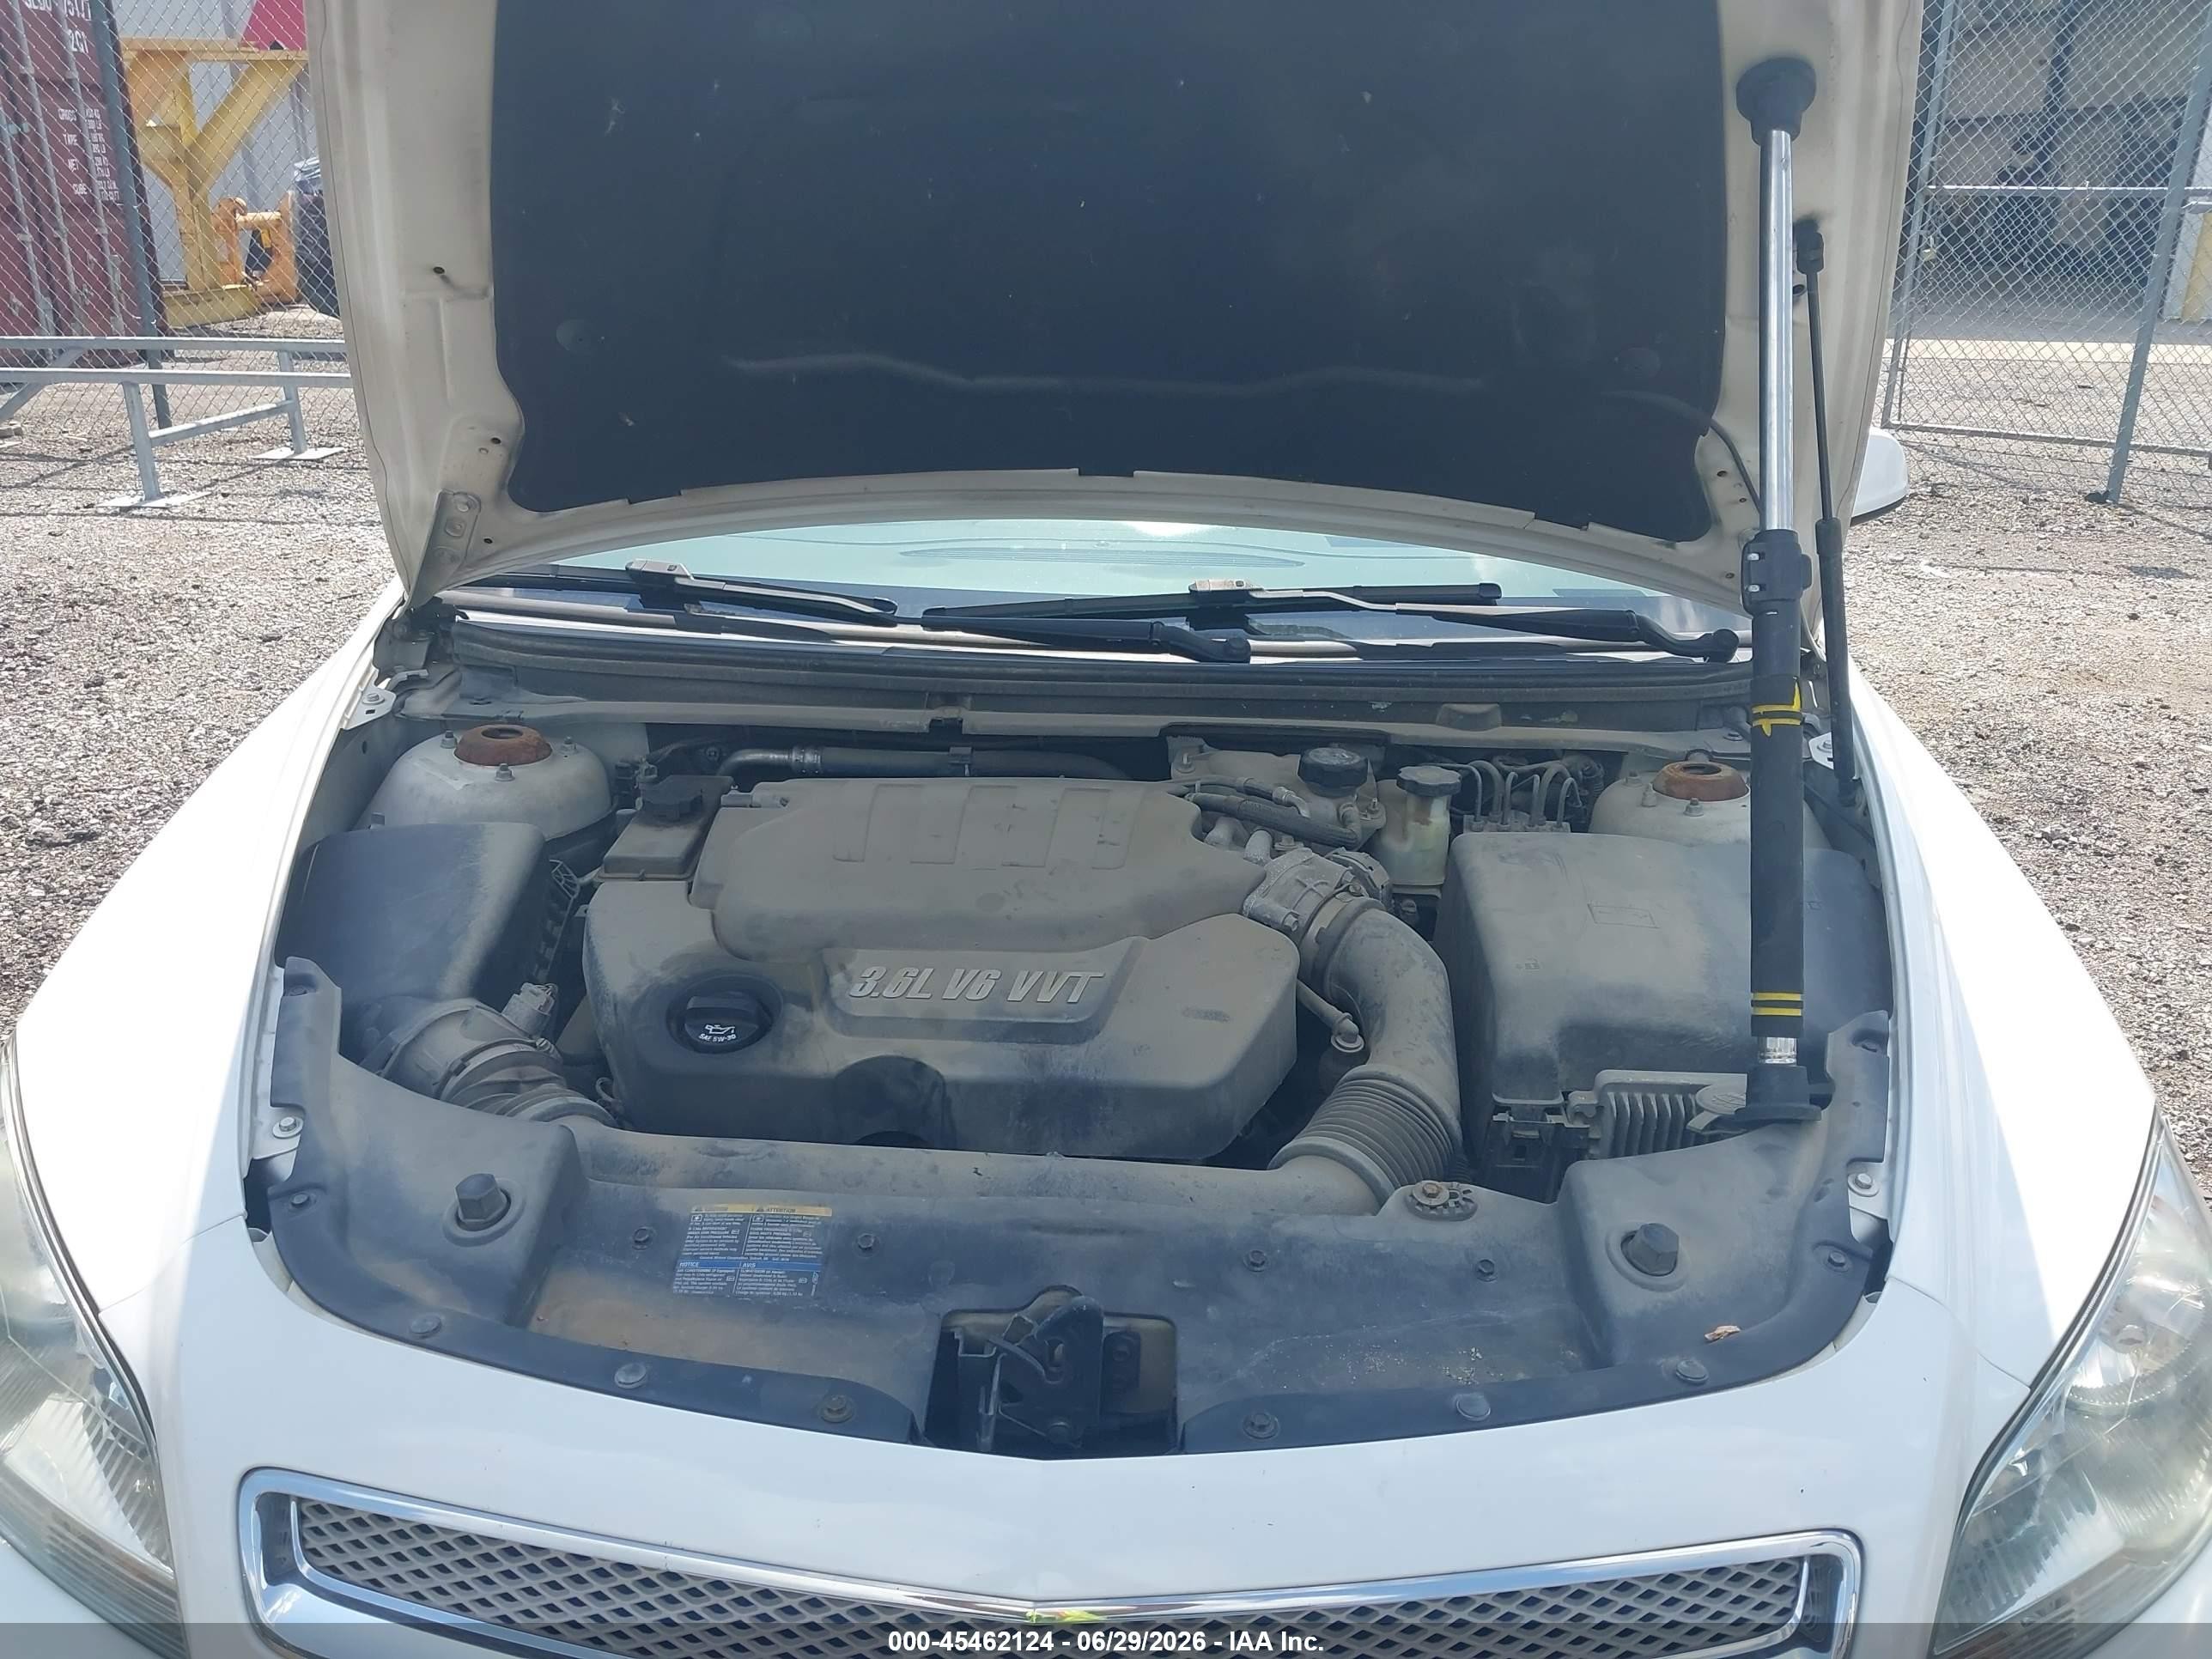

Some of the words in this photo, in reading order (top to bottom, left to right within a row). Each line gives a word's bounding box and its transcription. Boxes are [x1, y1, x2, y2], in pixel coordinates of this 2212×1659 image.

[848, 966, 935, 1000] 3.6L
[940, 969, 1002, 1001] V6
[1006, 970, 1106, 1004] VVT
